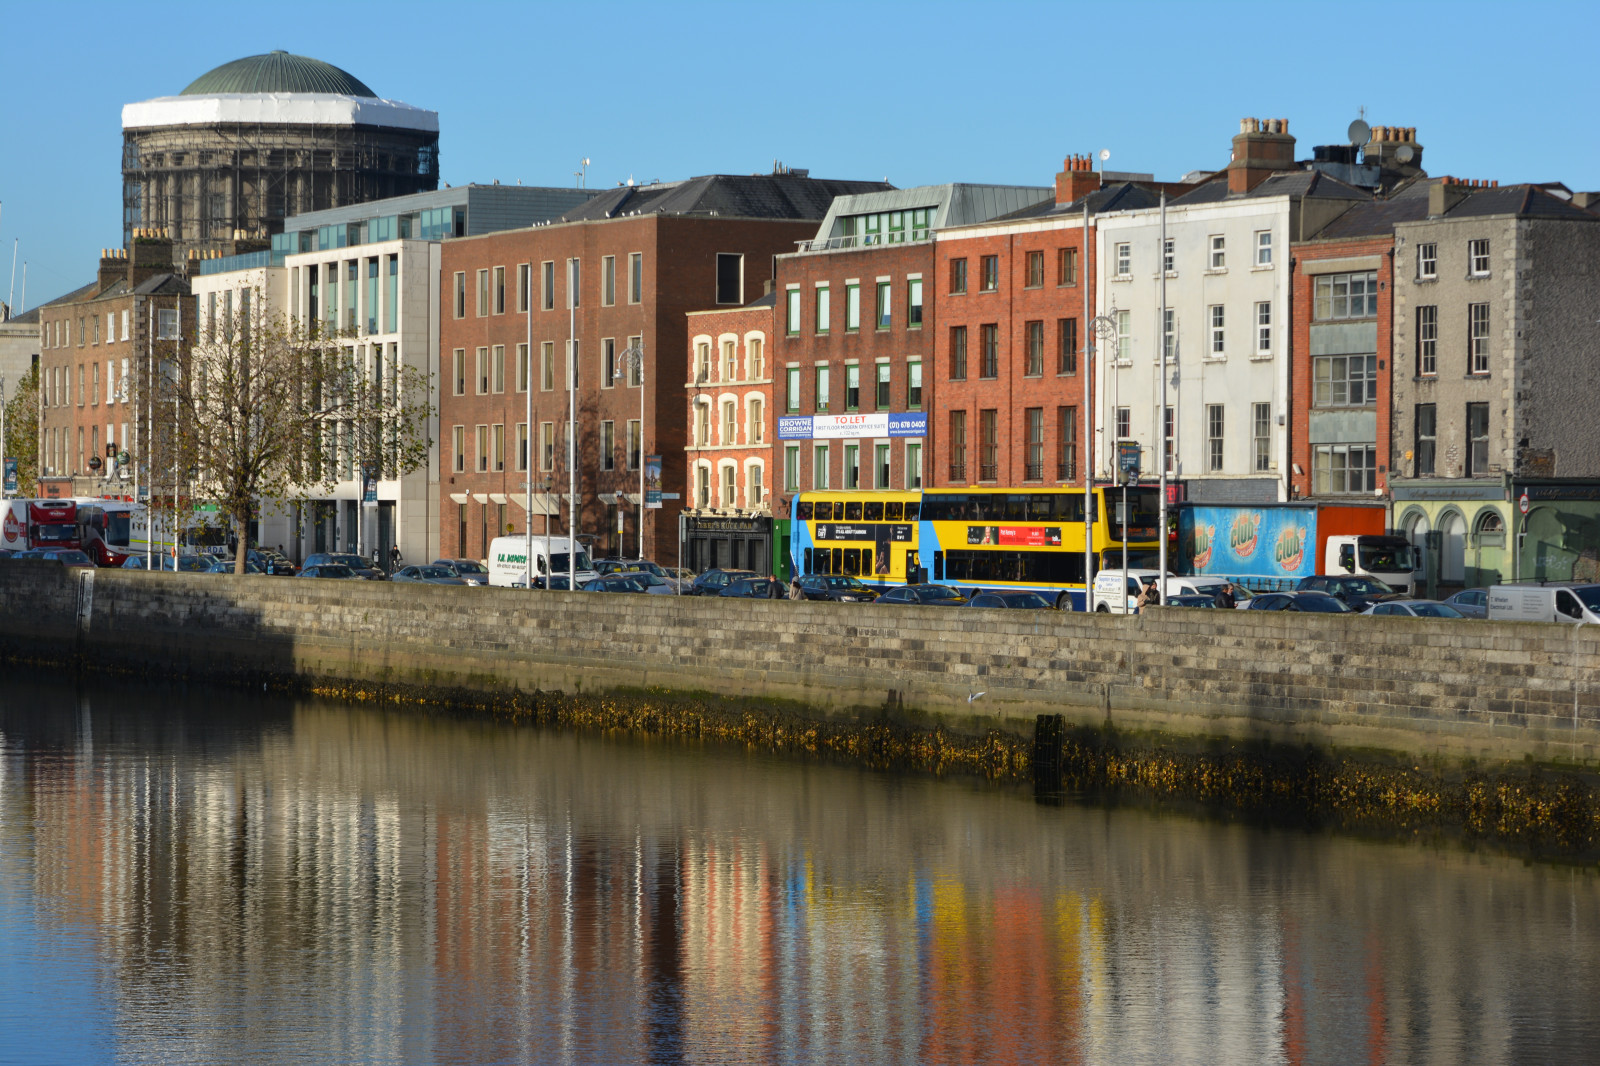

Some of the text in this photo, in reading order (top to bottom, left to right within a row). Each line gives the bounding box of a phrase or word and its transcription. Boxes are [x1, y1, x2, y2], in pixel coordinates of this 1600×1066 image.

[834, 415, 867, 424] TO LET
[889, 420, 926, 430] (01) 678 0400
[1231, 515, 1254, 548] club
[1276, 527, 1300, 562] club
